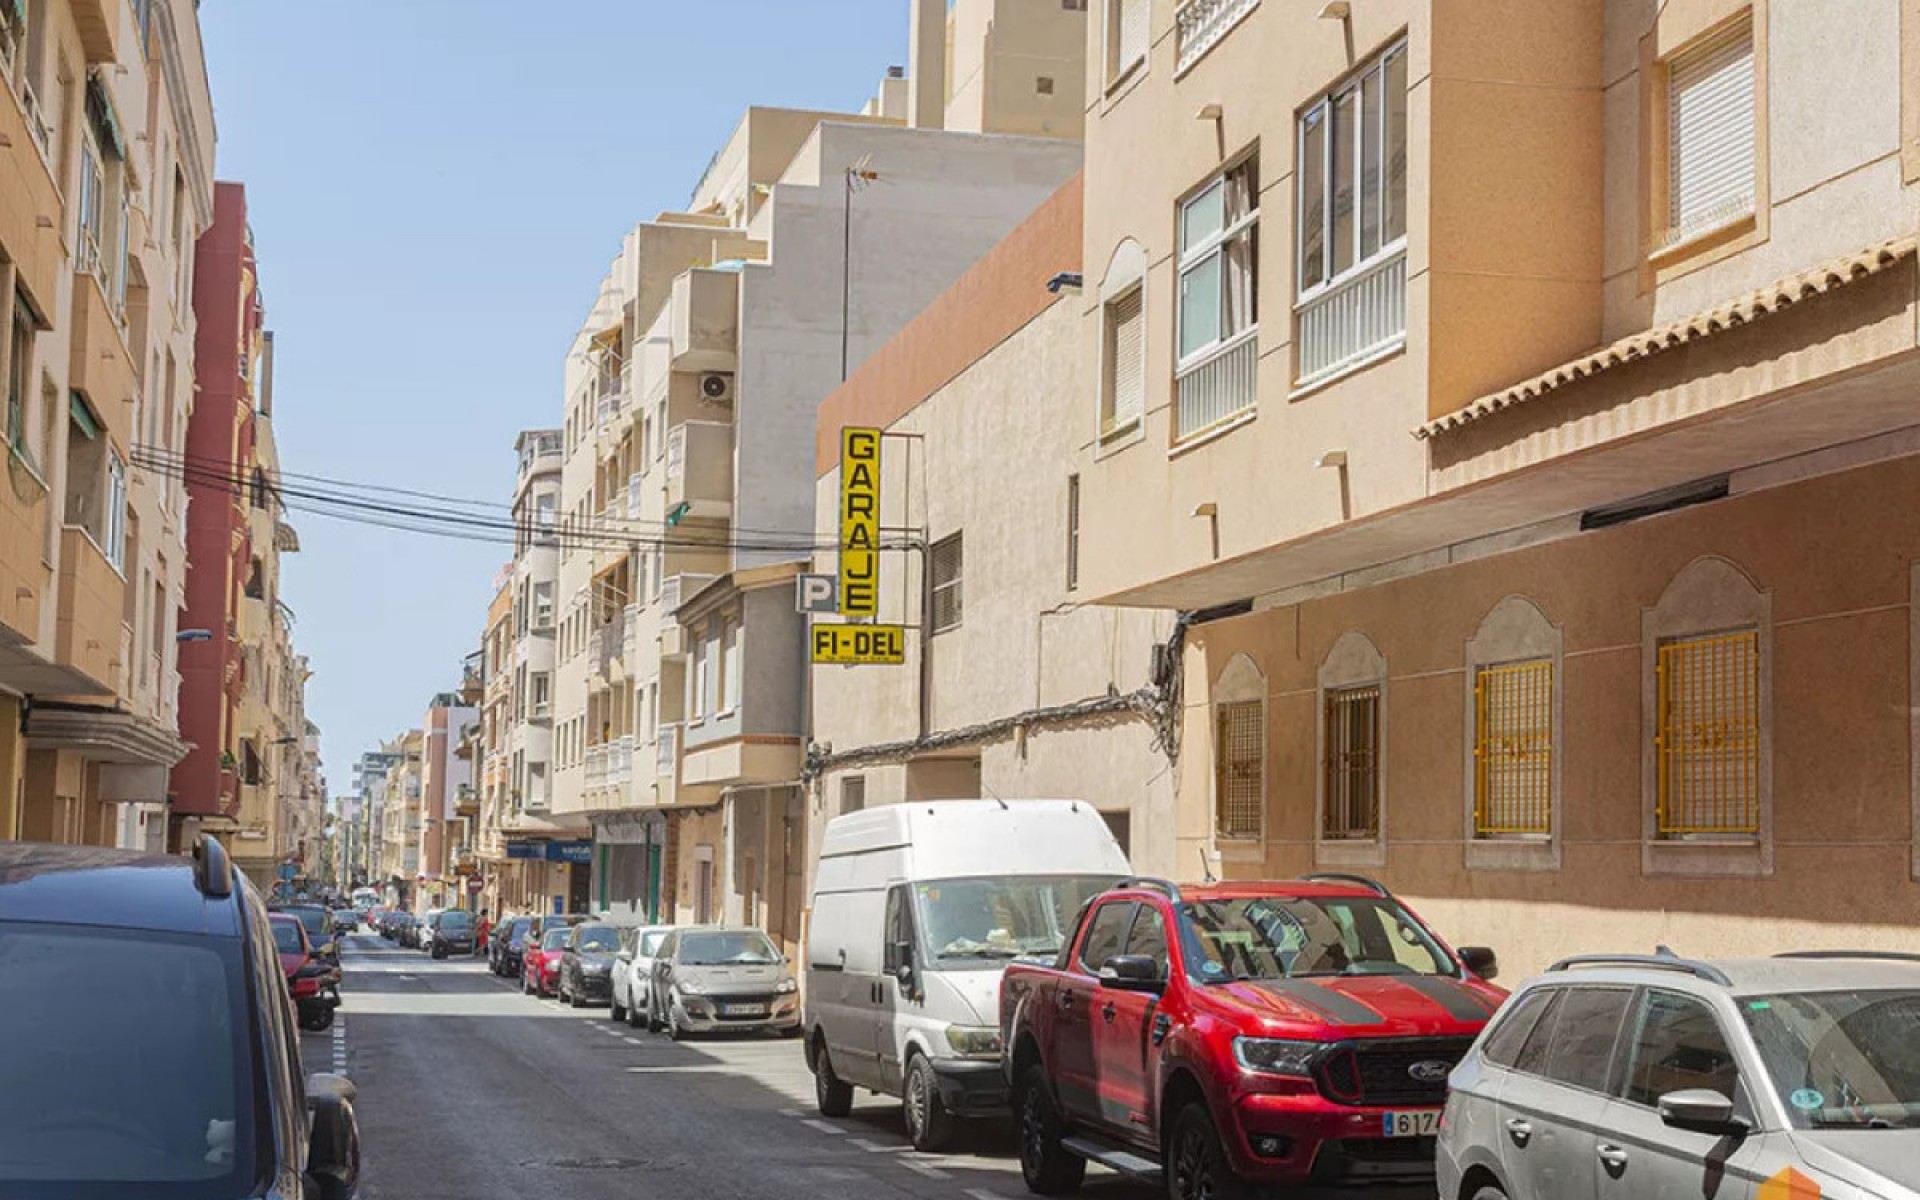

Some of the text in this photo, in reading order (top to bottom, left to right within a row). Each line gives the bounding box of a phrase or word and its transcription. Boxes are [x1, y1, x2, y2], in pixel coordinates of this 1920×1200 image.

[847, 433, 874, 611] GARAJE
[804, 578, 831, 608] P
[815, 631, 901, 655] FI-DEL
